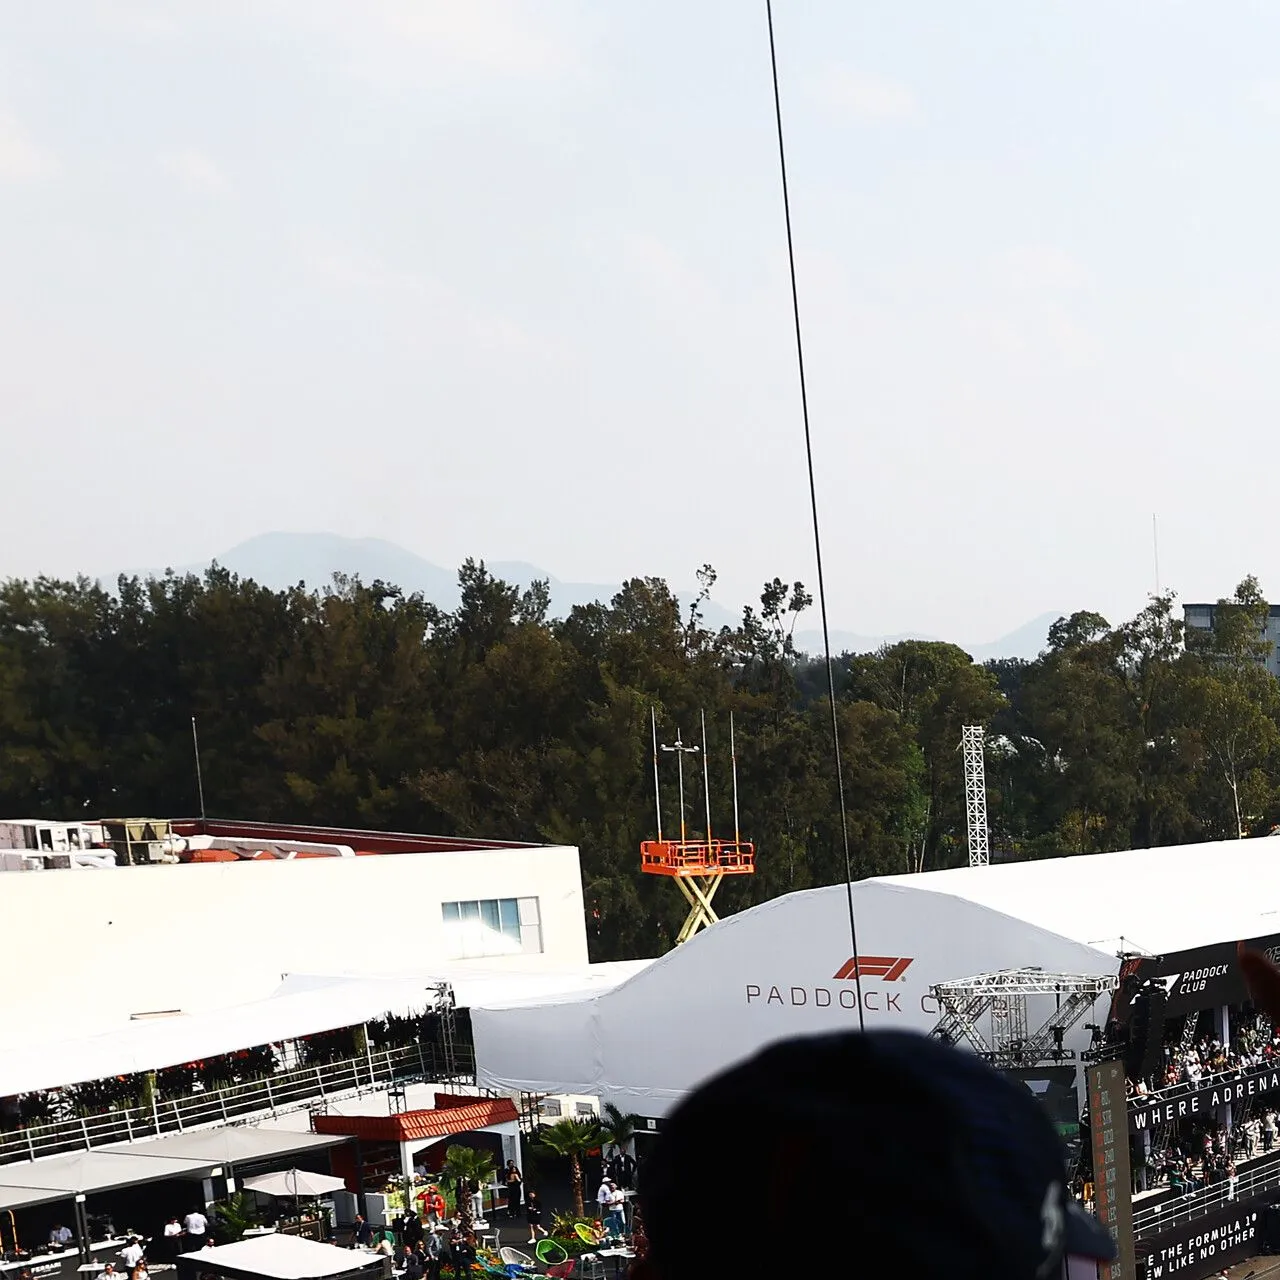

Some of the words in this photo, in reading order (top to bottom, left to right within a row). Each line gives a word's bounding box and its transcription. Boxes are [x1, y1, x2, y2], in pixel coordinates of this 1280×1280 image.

[1179, 979, 1207, 994] CLUB
[1183, 964, 1229, 982] PADDOCK
[746, 984, 901, 1012] PADDOCK
[1135, 1097, 1199, 1129] WHERE
[1161, 1243, 1184, 1262] THE
[1188, 1220, 1241, 1254] FORMULA
[1168, 1254, 1195, 1274] LIKE
[1200, 1243, 1216, 1261] NO
[1220, 1227, 1256, 1252] OTHER
